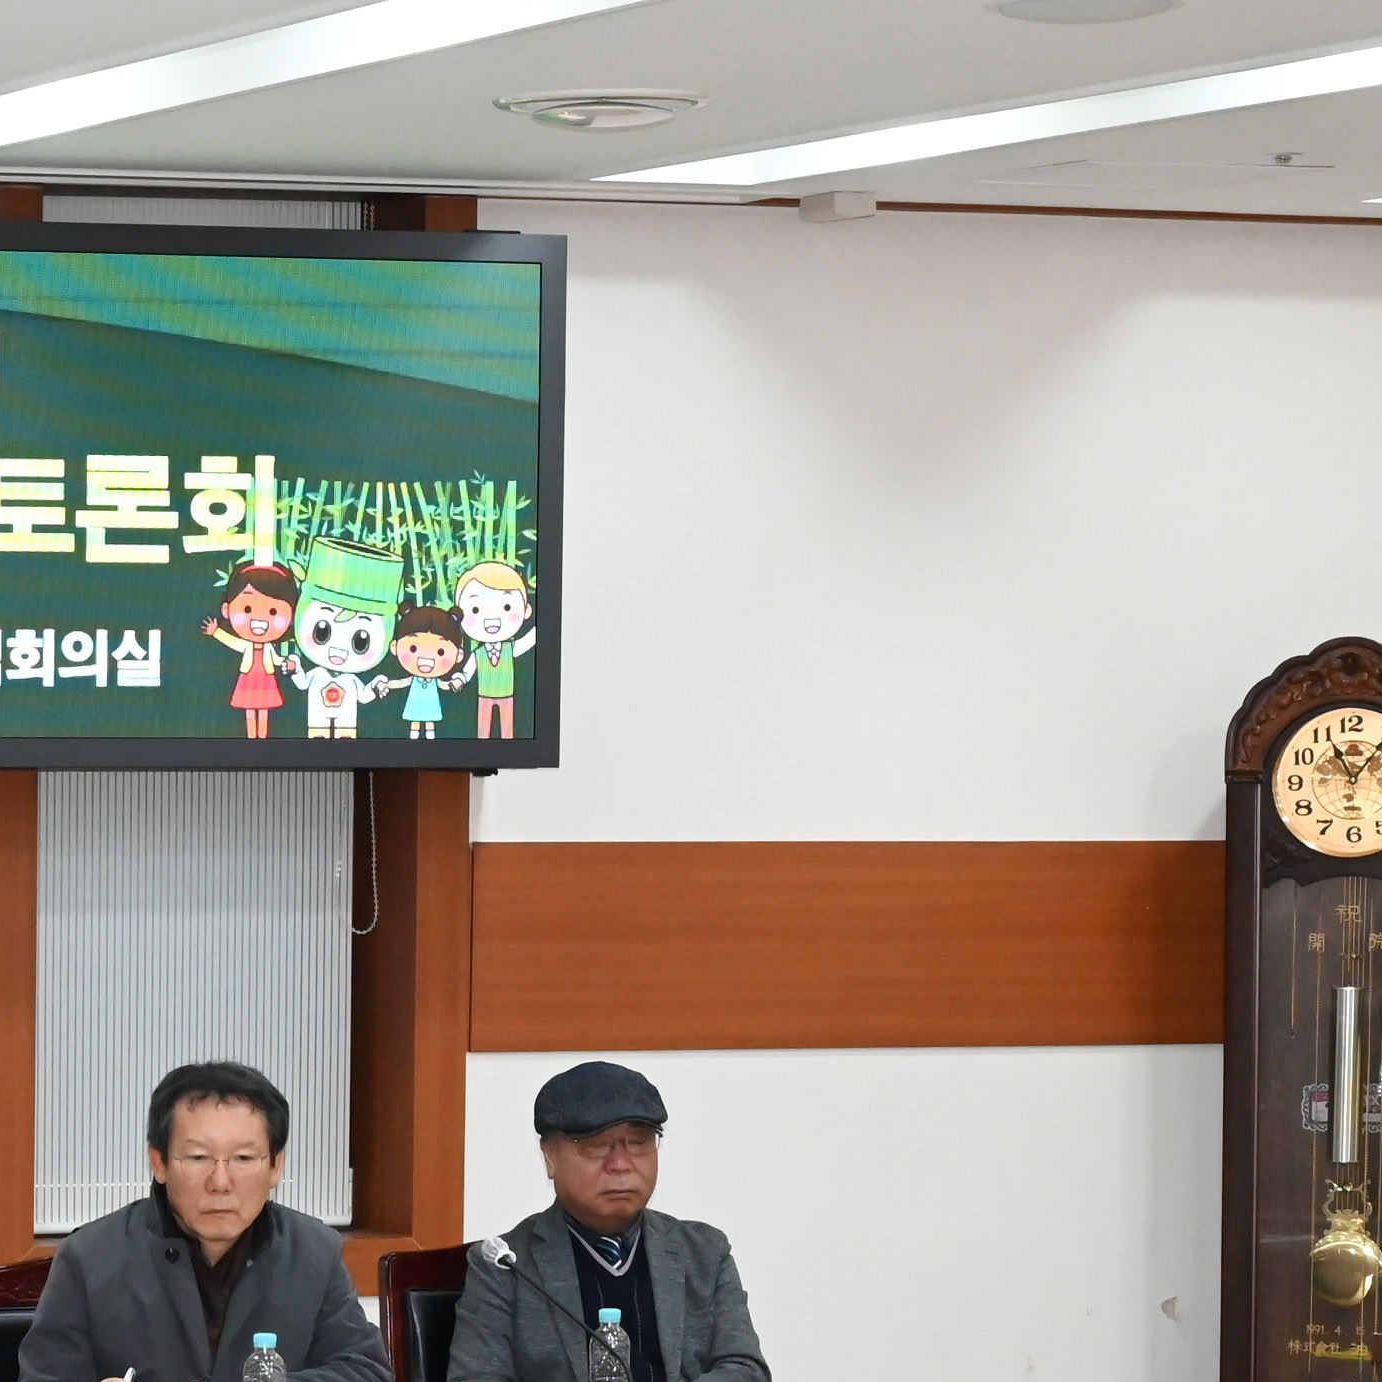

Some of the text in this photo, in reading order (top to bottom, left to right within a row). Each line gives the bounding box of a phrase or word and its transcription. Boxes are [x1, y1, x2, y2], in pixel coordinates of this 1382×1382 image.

[1340, 715, 1364, 733] 12
[1313, 725, 1332, 744] 11
[1294, 748, 1314, 766] 10
[1287, 774, 1304, 791] 9
[1295, 799, 1313, 816] 8
[1316, 818, 1334, 836] 7
[1346, 826, 1362, 843] 6
